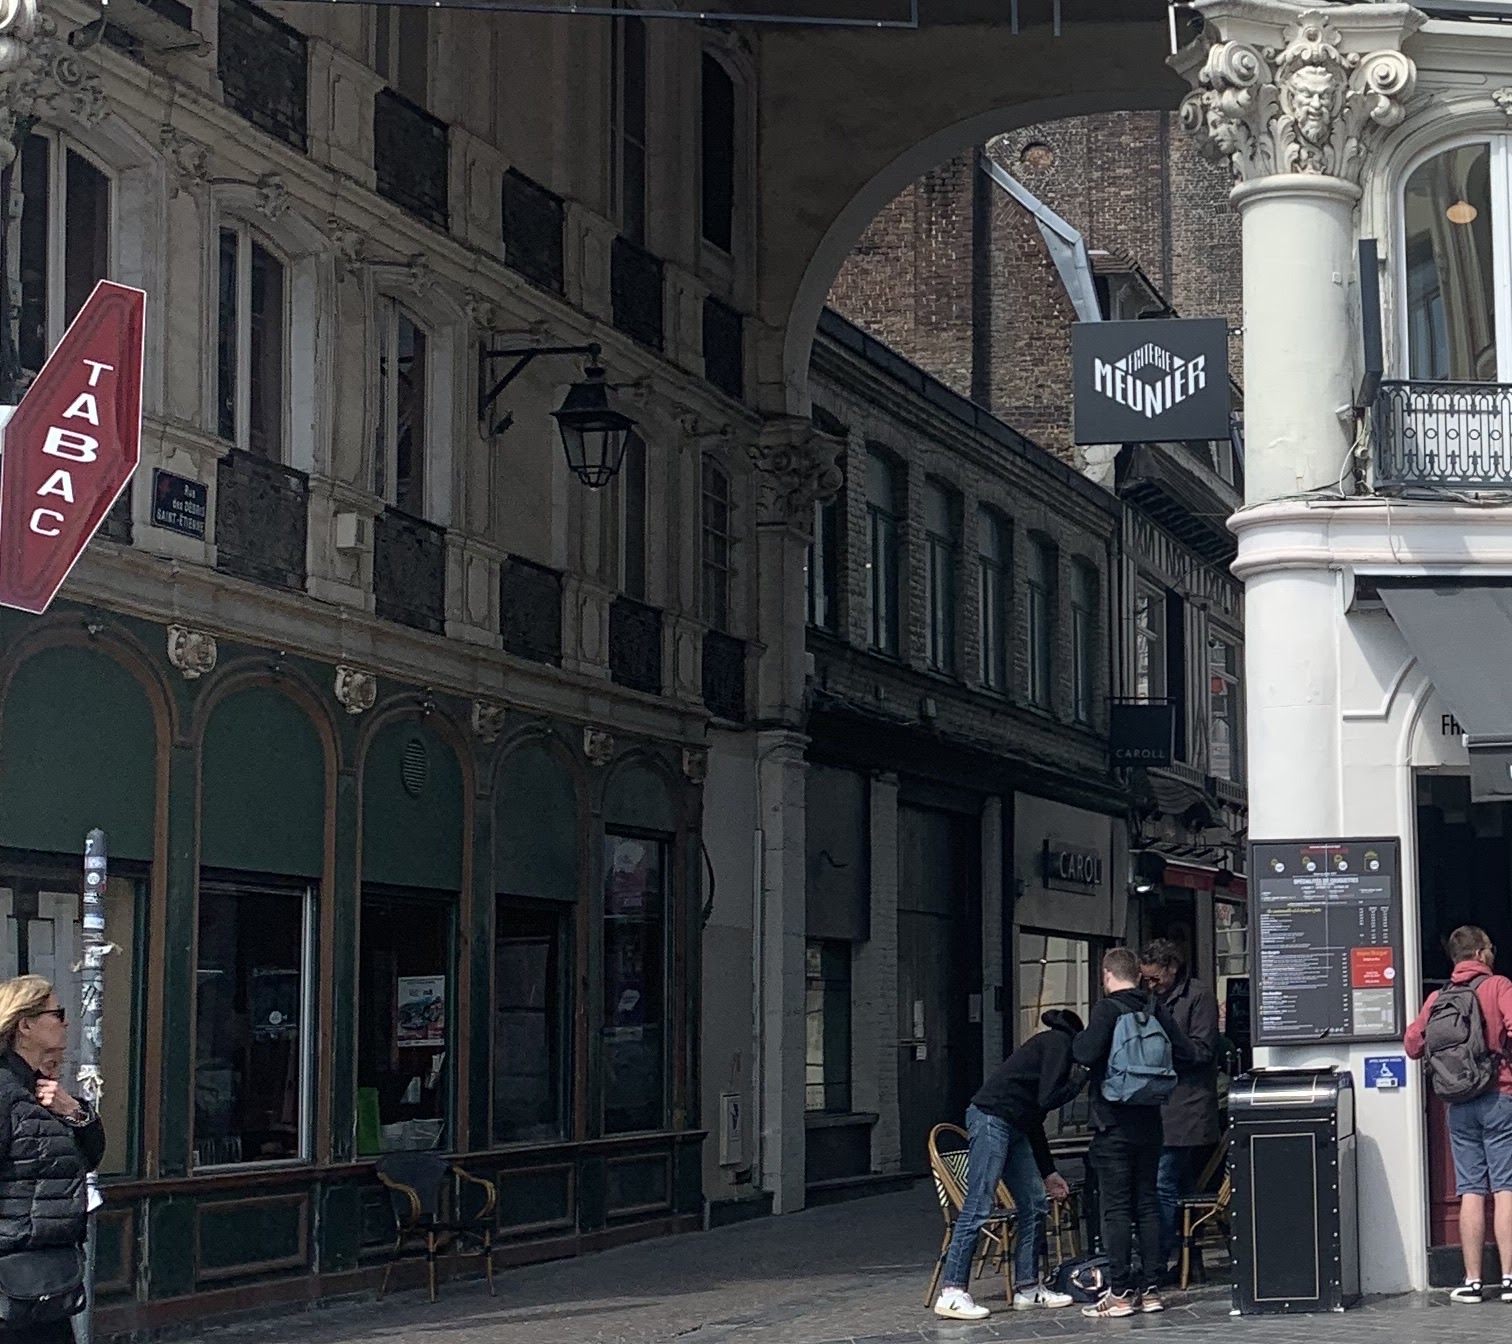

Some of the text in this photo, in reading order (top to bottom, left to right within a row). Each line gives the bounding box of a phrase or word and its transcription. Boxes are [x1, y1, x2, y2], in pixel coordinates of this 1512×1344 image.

[1128, 342, 1171, 374] FRITERIE
[1094, 354, 1206, 419] MEUNIER
[29, 358, 114, 537] TABAC
[1115, 748, 1167, 759] CAROLL
